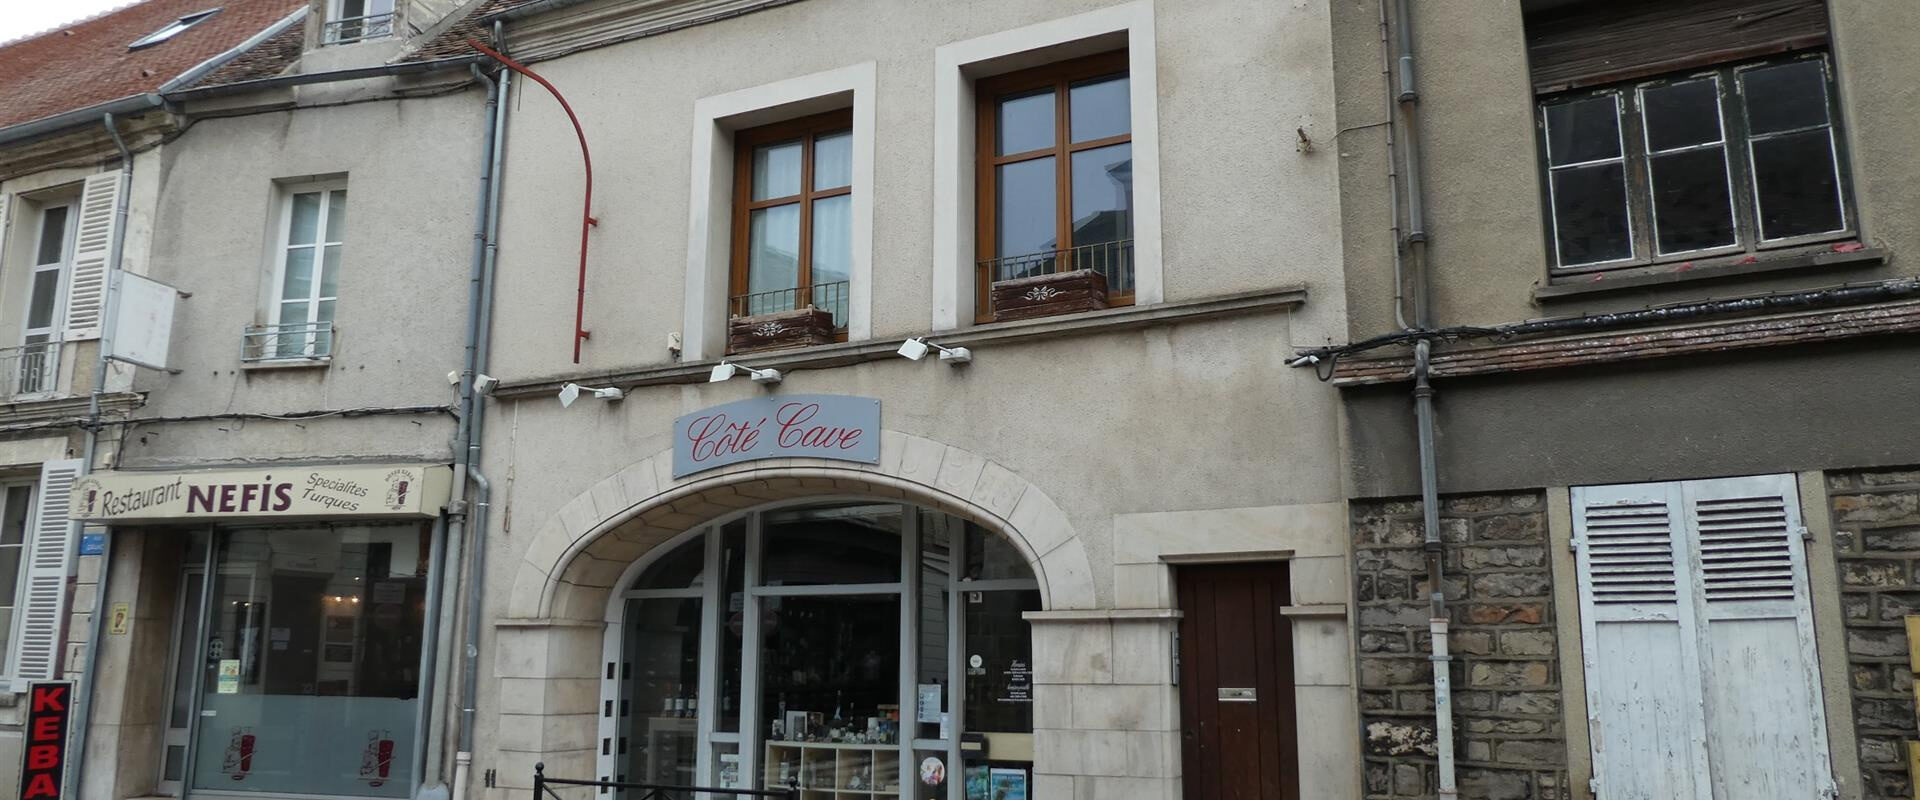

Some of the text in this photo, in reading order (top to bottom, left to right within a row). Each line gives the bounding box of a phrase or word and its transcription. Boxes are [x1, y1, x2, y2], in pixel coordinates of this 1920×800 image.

[687, 402, 863, 462] Côté Cave
[102, 476, 182, 516] Restaurant
[302, 487, 360, 511] Turques
[306, 472, 369, 497] Specialites
